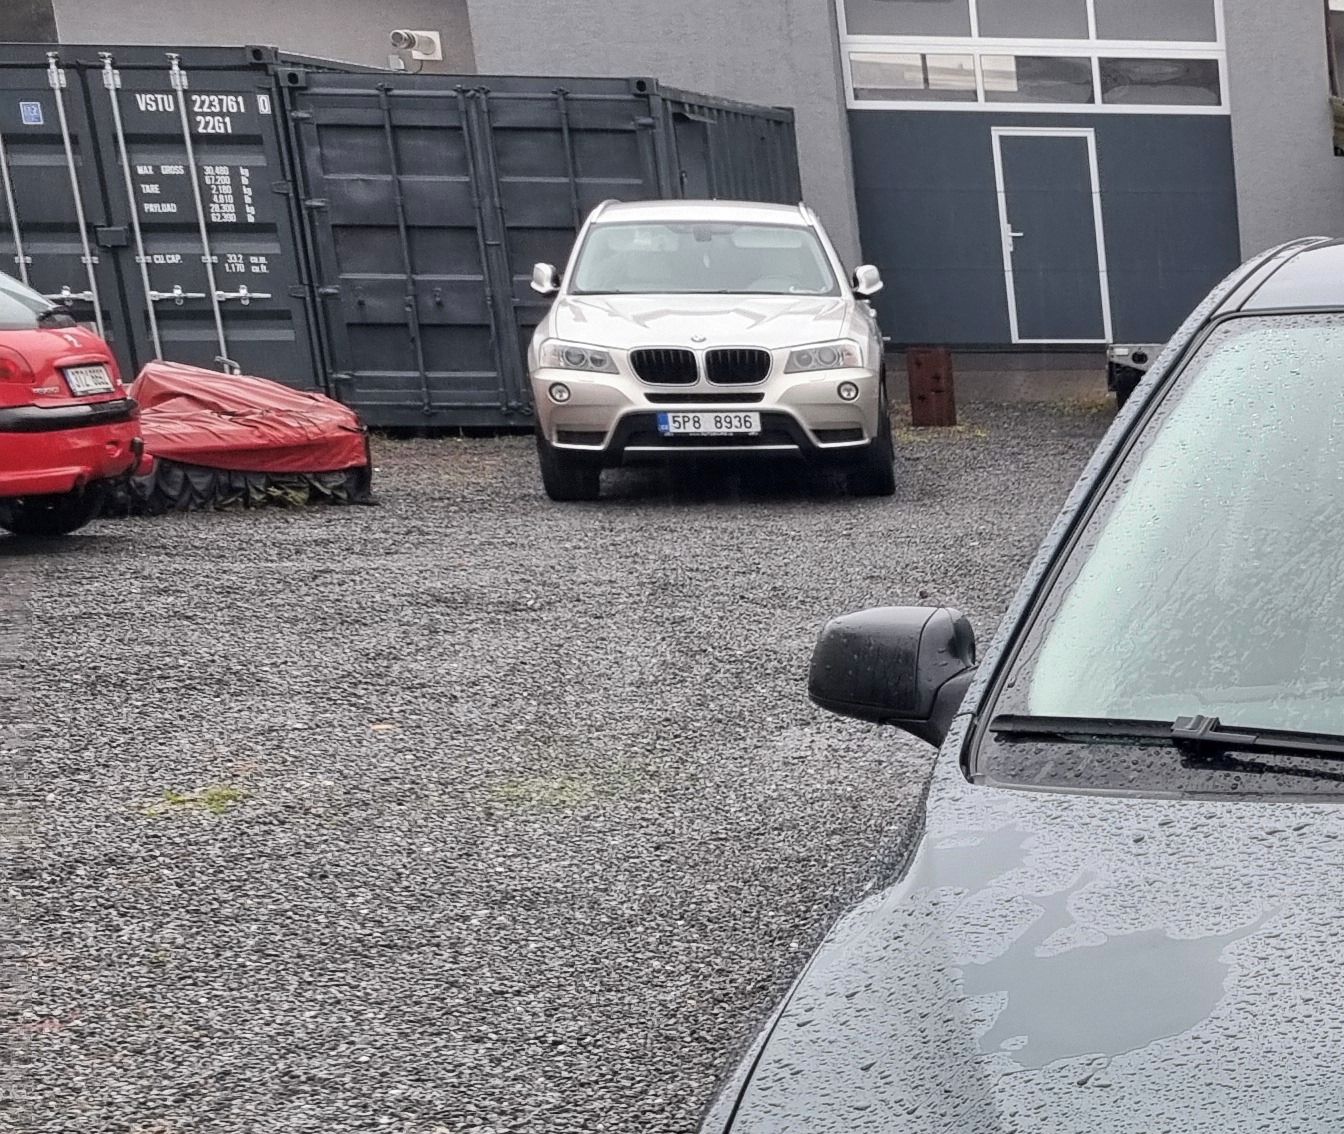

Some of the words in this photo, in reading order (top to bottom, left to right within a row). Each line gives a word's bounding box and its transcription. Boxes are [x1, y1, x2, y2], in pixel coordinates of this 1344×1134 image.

[136, 94, 175, 112] VSTU
[191, 95, 245, 113] 223761
[259, 96, 270, 113] 0
[196, 116, 232, 133] 22G1
[136, 165, 154, 175] MAX
[161, 165, 185, 175] GROSS
[140, 184, 161, 194] TARE
[144, 202, 177, 213] PAYLOAD
[671, 415, 702, 430] 5P8
[713, 414, 753, 430] 8936
